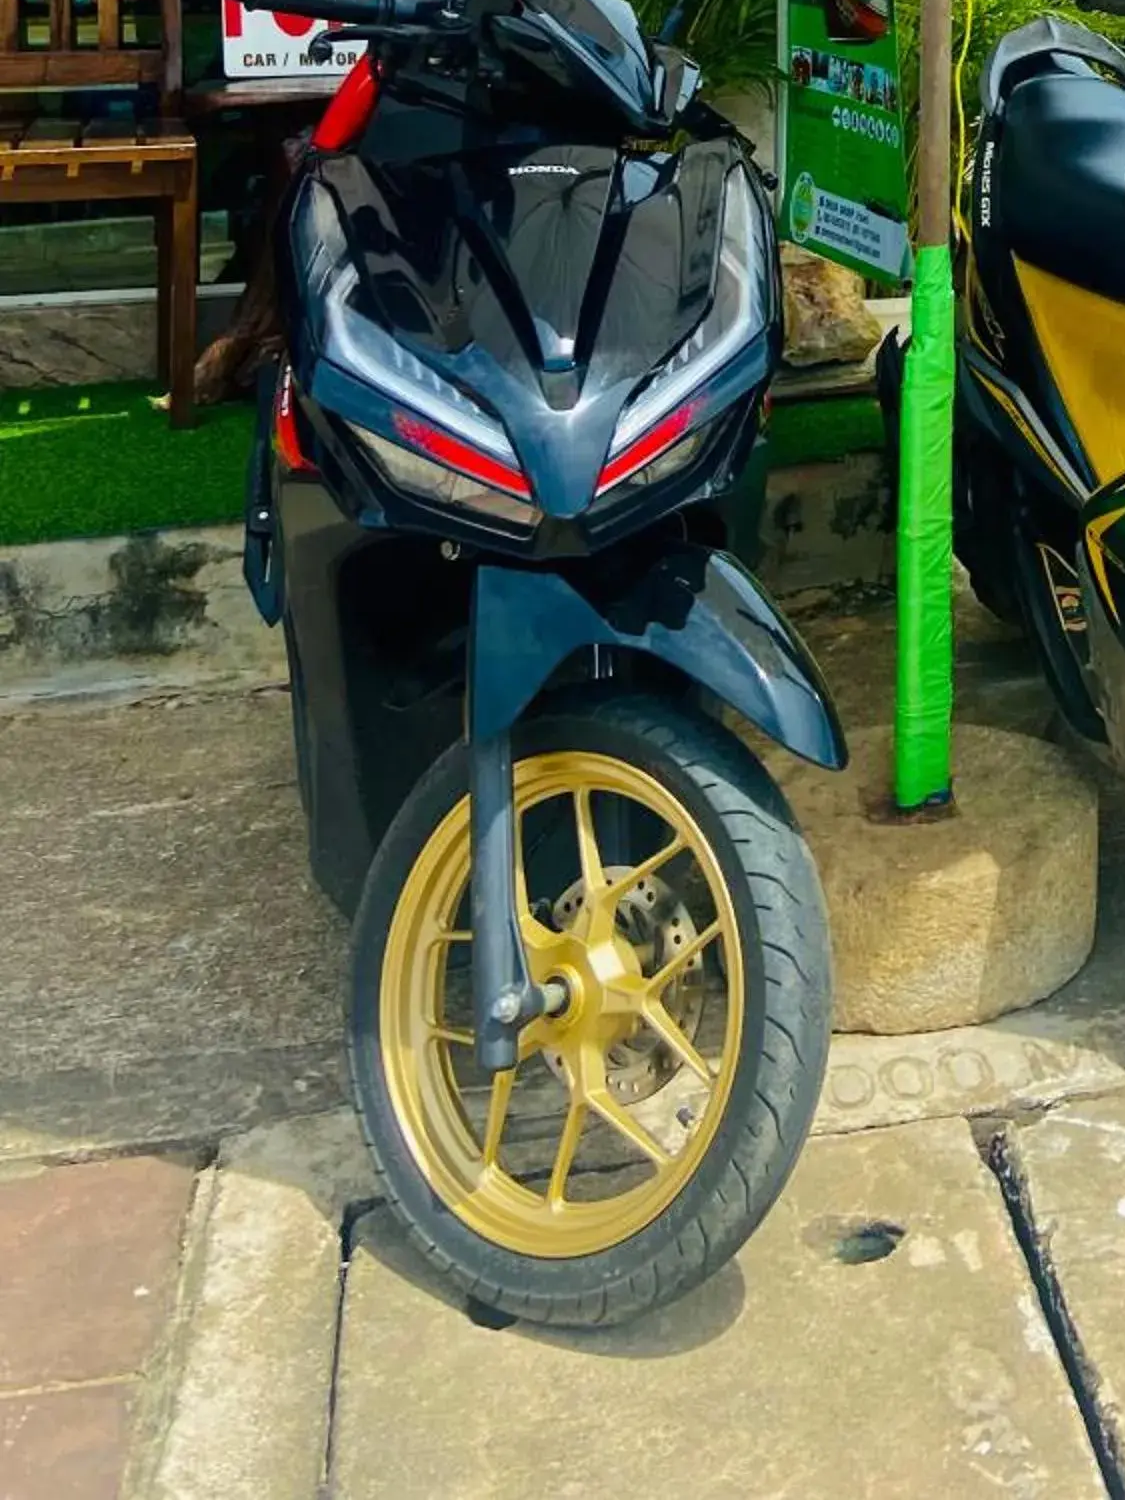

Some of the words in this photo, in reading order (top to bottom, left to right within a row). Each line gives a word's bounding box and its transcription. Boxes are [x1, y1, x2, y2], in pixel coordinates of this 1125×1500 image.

[243, 53, 277, 67] CAR
[300, 52, 357, 67] MTOR
[508, 164, 581, 176] HONDA
